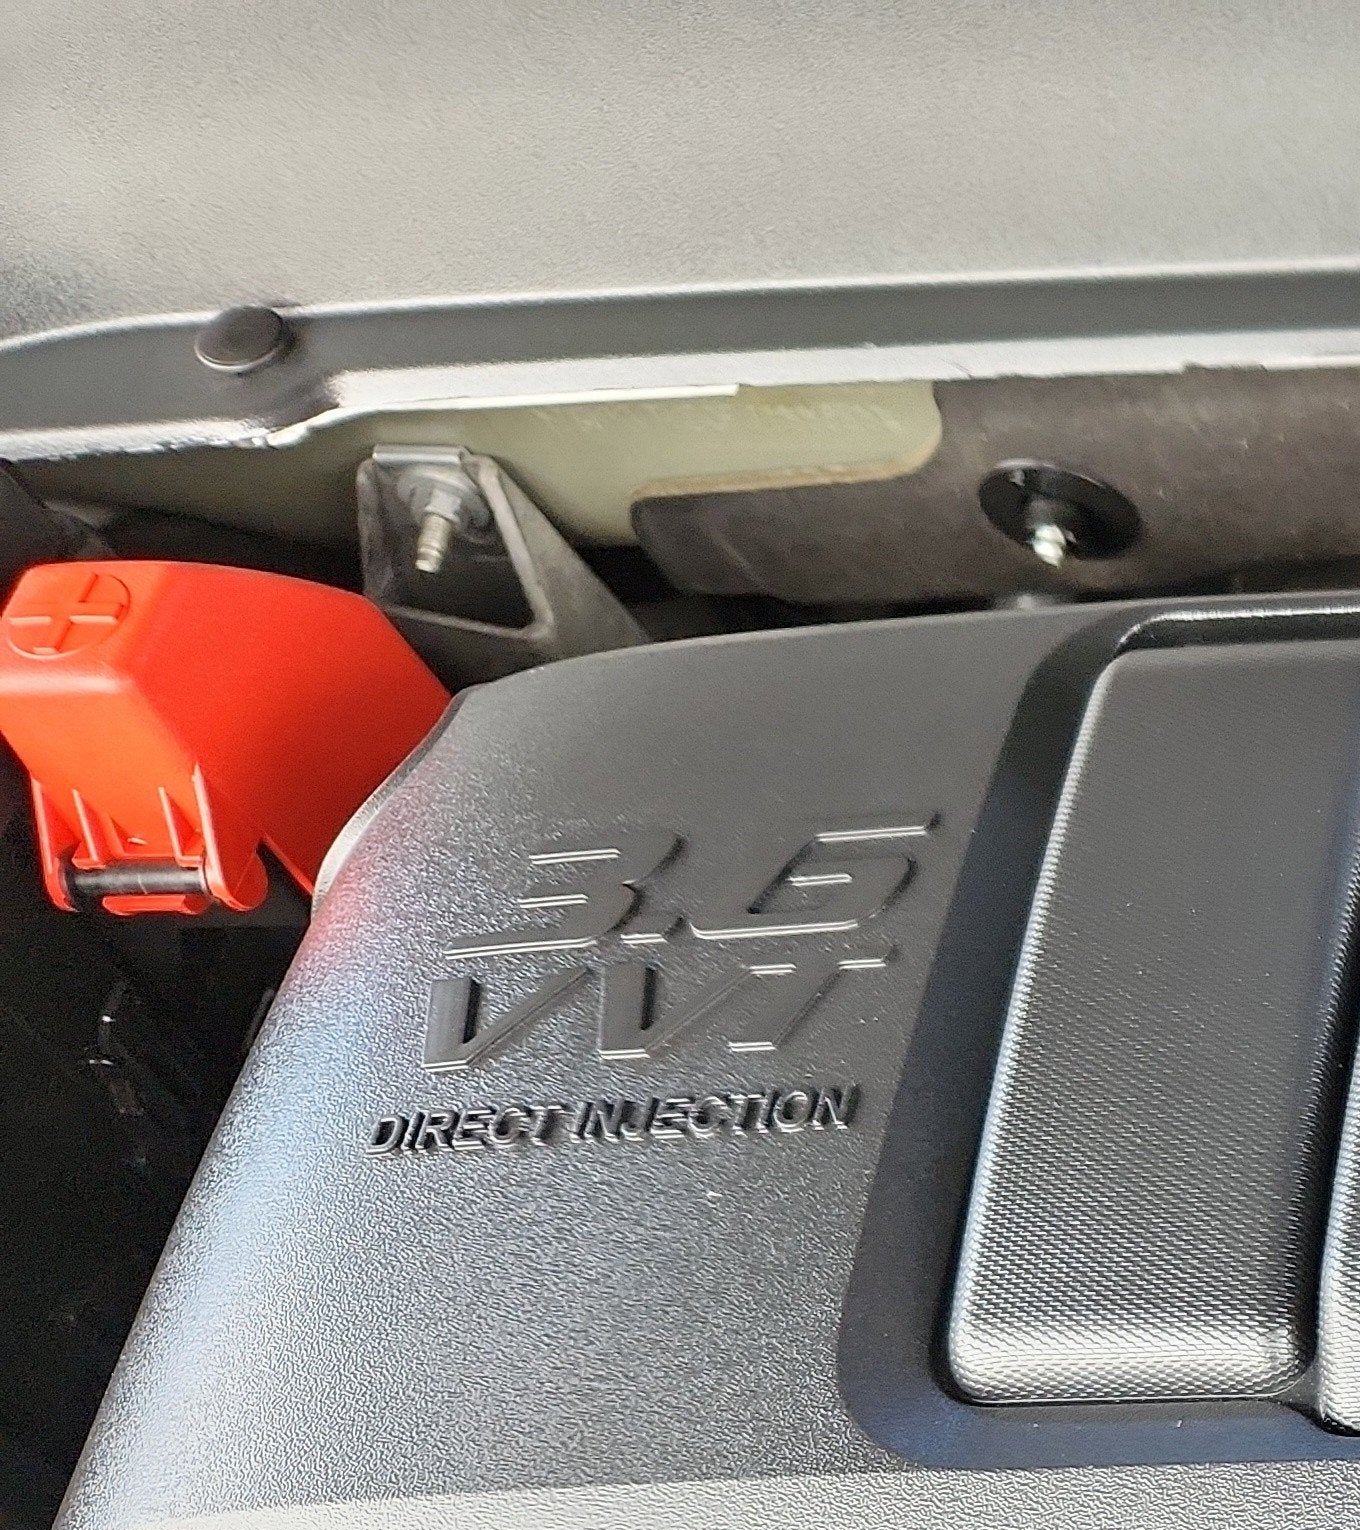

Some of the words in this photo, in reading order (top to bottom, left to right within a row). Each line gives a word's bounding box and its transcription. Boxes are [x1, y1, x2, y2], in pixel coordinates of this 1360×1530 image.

[444, 812, 942, 959] 3.6
[421, 946, 897, 1073] VVT
[366, 1103, 574, 1157] DIRECT
[568, 1083, 862, 1144] INJECTION
